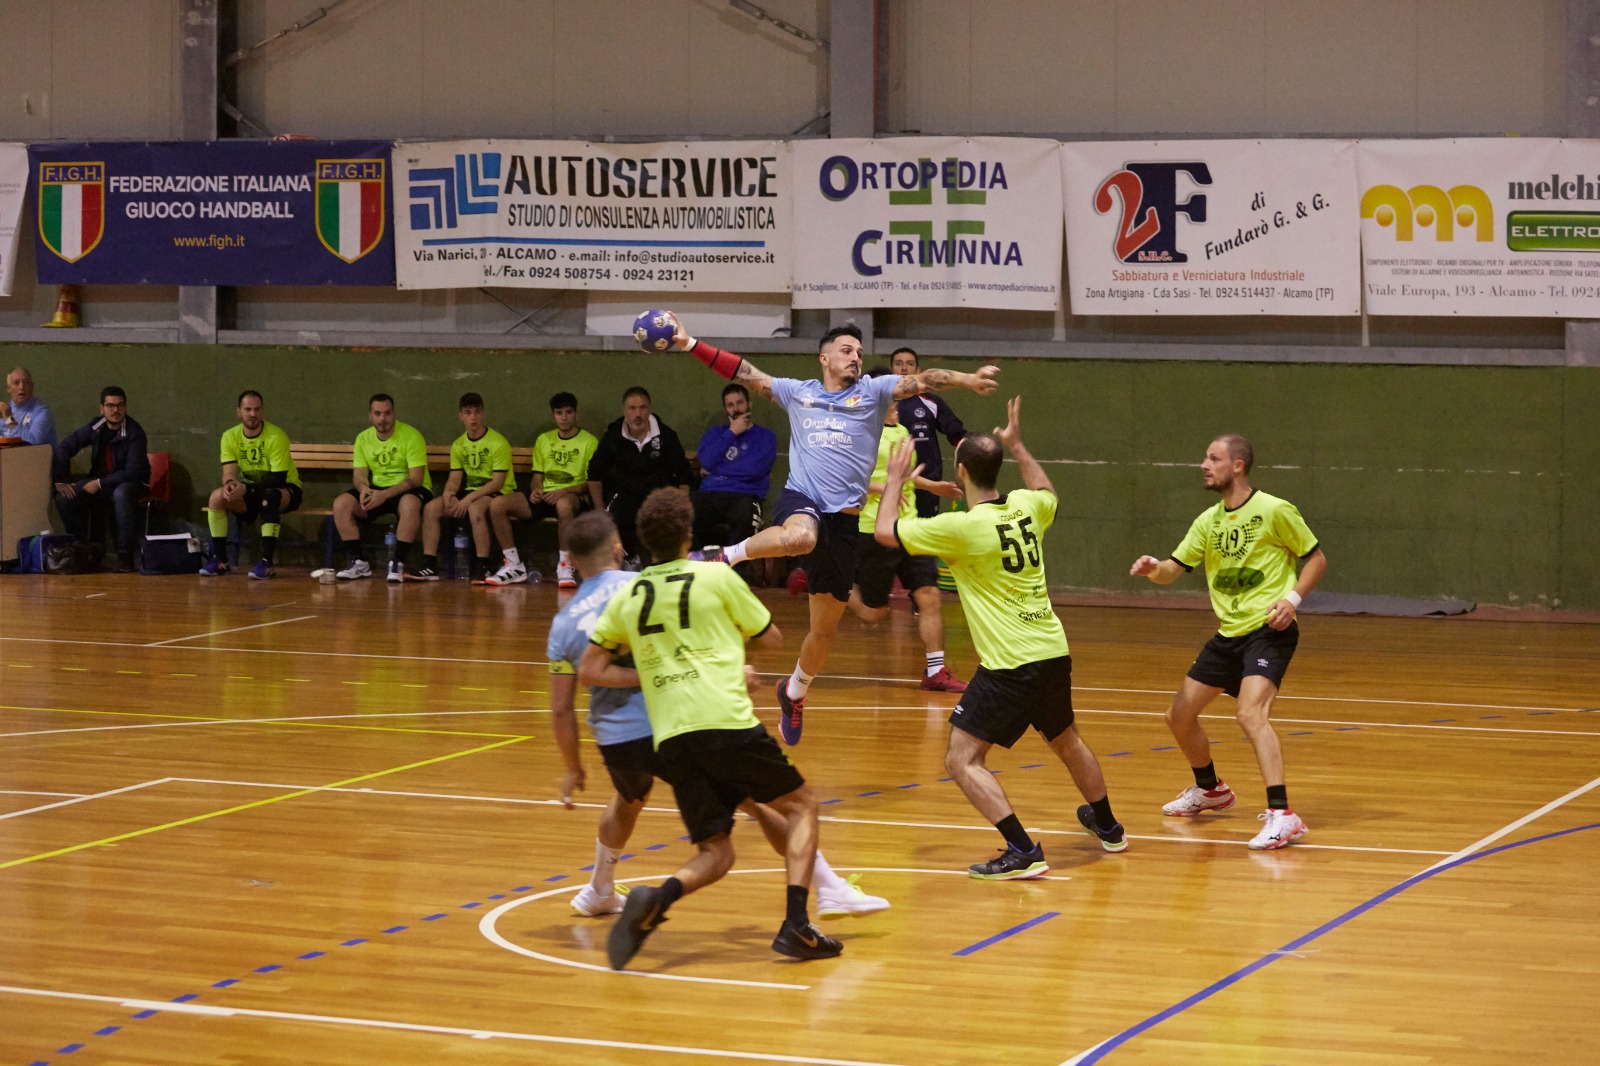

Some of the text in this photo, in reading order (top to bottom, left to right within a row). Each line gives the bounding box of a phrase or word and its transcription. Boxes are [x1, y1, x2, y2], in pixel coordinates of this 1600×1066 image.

[45, 166, 101, 181] F.I.G.H.
[321, 163, 381, 179] F.I.G.H.
[503, 154, 778, 199] AUTOSERVICE
[818, 154, 1009, 201] ORTOPEDIA
[109, 174, 312, 193] FEDERAZIONE ITALIANA
[125, 201, 294, 219] GIUOCO HANDBALL
[1250, 191, 1266, 212] di
[507, 203, 776, 230] STUDIO DI CONSULENZA AUTOMOBILISTICA
[1204, 193, 1330, 260] Fundarò G. & G.
[1511, 225, 1600, 238] ELETTRO
[173, 234, 245, 250] www.figh.it
[413, 250, 434, 262] Via
[438, 247, 478, 262] Narici,
[496, 247, 557, 260] ALCAMO
[568, 250, 611, 263] e.mail:
[614, 250, 775, 265] info@studioautoservice.it
[483, 264, 525, 278] el./Fax
[529, 266, 560, 279] 0924
[564, 267, 611, 280] 508754
[623, 268, 654, 281] 0924
[657, 269, 695, 282] 23121
[1111, 269, 1305, 281] Sabbiatura e Verniciatura Industriale
[852, 280, 880, 291] ALCAMO
[881, 280, 894, 292] (TP)
[900, 281, 911, 291] Tel.
[1085, 287, 1106, 299] Zona
[1107, 287, 1145, 301] Artigiana
[1173, 287, 1191, 299] Sasi
[1199, 287, 1212, 299] Tel.
[1215, 287, 1275, 299] 0924.514437
[1283, 287, 1313, 299] Alcamo
[1315, 287, 1334, 301] (TP)
[1367, 283, 1397, 297] Viale
[1401, 283, 1451, 300] Europa,
[1455, 285, 1476, 297] 193
[1489, 285, 1536, 298] Alcamo
[1548, 285, 1568, 298] Tel.
[250, 448, 257, 460] 2
[995, 515, 1041, 574] 55
[1225, 528, 1239, 551] 19
[631, 572, 695, 637] 27
[652, 669, 700, 688] Ginevra
